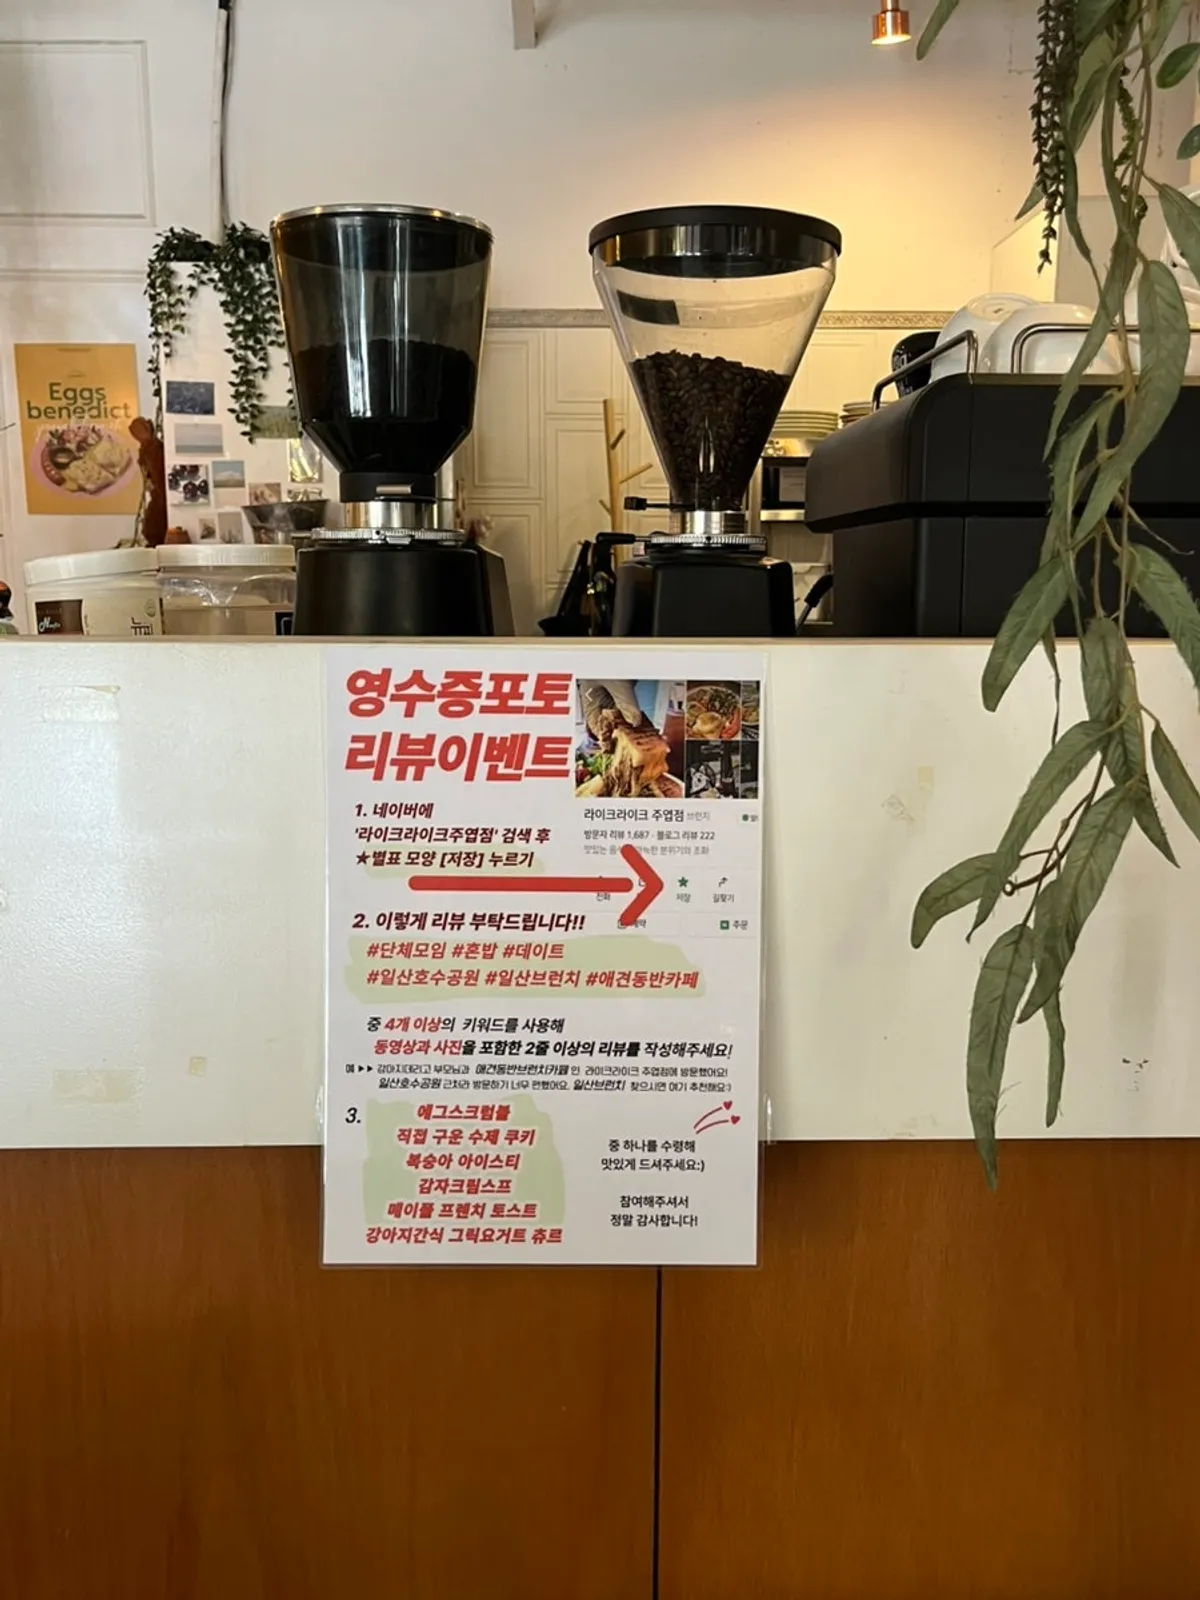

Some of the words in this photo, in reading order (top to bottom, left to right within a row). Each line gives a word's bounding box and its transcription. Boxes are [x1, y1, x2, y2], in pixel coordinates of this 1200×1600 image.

[49, 382, 106, 408] Eggs
[27, 400, 132, 420] benedict
[345, 667, 574, 718] 영수증포토
[344, 732, 573, 782] 리뷰이벤트
[354, 804, 368, 817] 1.
[372, 803, 434, 818] 네이버에
[584, 809, 648, 822] 라이크라이크
[652, 809, 684, 823] 주엽점
[354, 827, 498, 844] '라이크라이크주엽점'
[502, 828, 532, 844] 검색
[535, 828, 551, 844] 후
[584, 830, 607, 840] 방문자
[610, 830, 625, 840] 리뷰
[628, 830, 650, 840] 1,687
[657, 830, 680, 840] 블로그
[682, 830, 698, 840] 리뷰
[700, 831, 716, 840] 222
[372, 851, 402, 867] 별표
[405, 851, 436, 868] 모양
[440, 852, 484, 868] [저장]
[489, 852, 535, 868] 누르기
[352, 914, 370, 928] 2.
[376, 912, 428, 930] 이렇게
[431, 913, 466, 931] 리뷰
[470, 913, 586, 932] 부탁드립니다!!
[732, 920, 748, 930] 주문
[367, 942, 446, 960] #단체모임
[452, 942, 498, 960] #혼밥
[502, 943, 564, 960] #데이트
[366, 969, 480, 987] #일산호수공원
[484, 970, 581, 988] #일산브런치
[586, 971, 699, 989] #애견동반카페
[367, 1017, 382, 1032] 중
[384, 1017, 410, 1032] 4개
[414, 1017, 456, 1032] 이상의
[462, 1018, 518, 1033] 키워드를
[522, 1018, 566, 1034] 사용해
[374, 1039, 430, 1055] 동영상과
[434, 1040, 476, 1056] 사진을
[479, 1041, 522, 1056] 포함한
[524, 1041, 550, 1056] 2줄
[554, 1041, 596, 1057] 이상의
[598, 1042, 640, 1057] 리뷰를
[644, 1042, 733, 1059] 작성해주세요!
[434, 1064, 470, 1074] 부모님과
[585, 1066, 640, 1076] 라이크라이크
[378, 1077, 442, 1089] 일산호수공원
[472, 1080, 509, 1090] 방문하기
[511, 1080, 530, 1090] 너무
[574, 1079, 626, 1091] 일산브런치
[669, 1082, 688, 1092] 여기
[345, 1107, 362, 1124] 3.
[417, 1104, 512, 1121] 에그스크럼블
[397, 1128, 428, 1145] 직접
[432, 1129, 464, 1145] 구운
[468, 1129, 500, 1146] 수제
[504, 1129, 536, 1146] 쿠키
[608, 1139, 620, 1152] 중
[623, 1140, 658, 1152] 하나를
[661, 1140, 696, 1152] 수령해
[406, 1154, 454, 1170] 복숭아
[458, 1154, 521, 1170] 아이스티
[601, 1158, 636, 1171] 맛있게
[638, 1158, 706, 1172] 드셔주세요:)
[418, 1178, 512, 1195] 감자크림스프
[620, 1195, 690, 1208] 참여해주셔서
[387, 1203, 435, 1220] 메이플
[438, 1203, 486, 1220] 프렌치
[490, 1204, 538, 1219] 토스트
[610, 1214, 634, 1227] 정말
[636, 1214, 698, 1228] 감사합니다!
[365, 1227, 444, 1244] 강아지간식
[448, 1228, 527, 1244] 그릭요거트
[531, 1228, 563, 1244] 츄르
